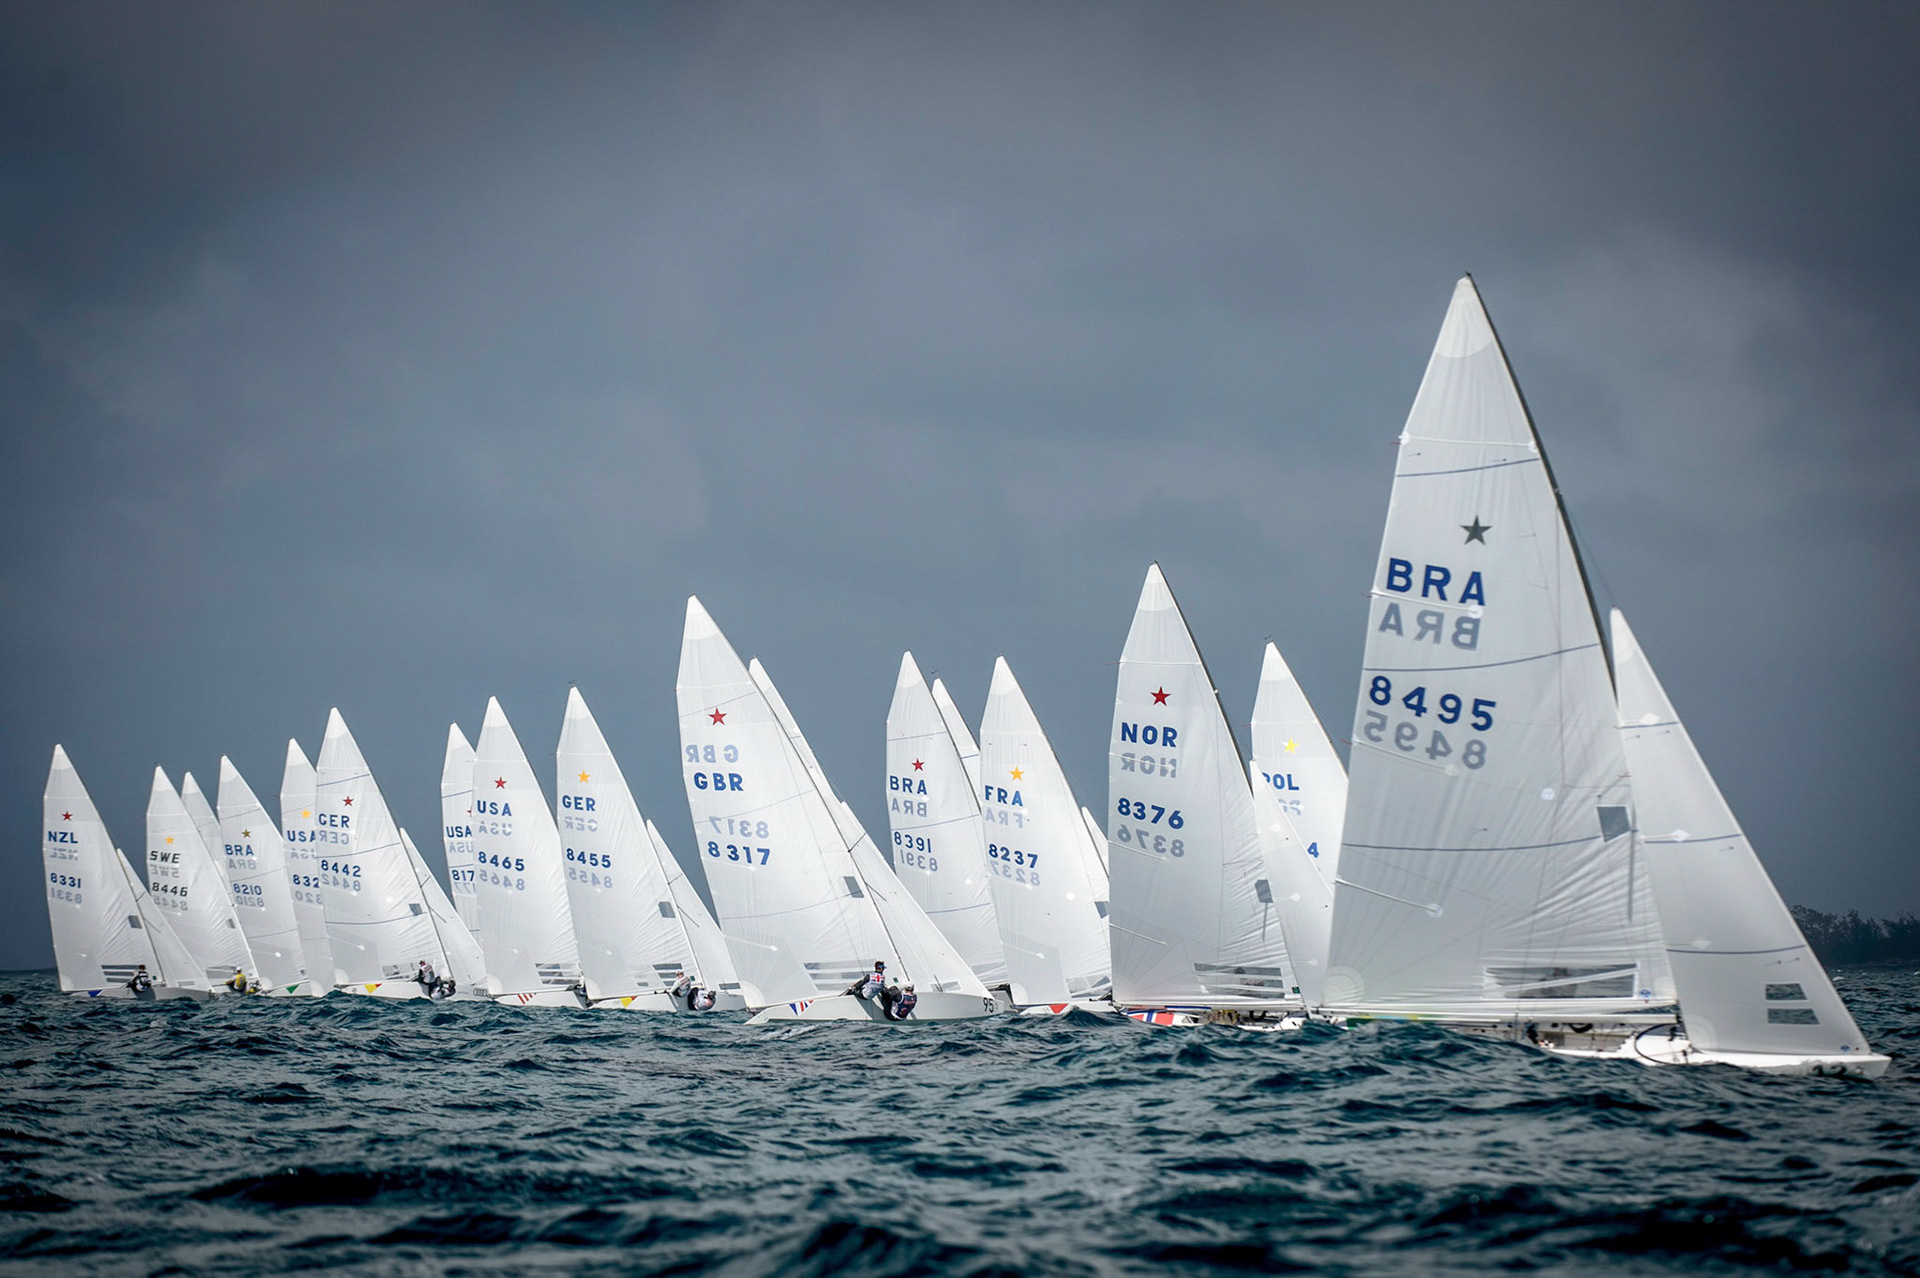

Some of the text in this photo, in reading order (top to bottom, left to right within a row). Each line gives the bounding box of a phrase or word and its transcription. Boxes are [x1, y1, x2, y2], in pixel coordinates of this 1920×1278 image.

[1386, 557, 1486, 606] BRA
[1369, 675, 1496, 732] 8495
[1121, 722, 1178, 747] NOR
[693, 772, 744, 791] GBR
[889, 775, 928, 795] BRA
[562, 794, 596, 812] GER
[984, 784, 1024, 807] FRA
[477, 799, 512, 817] USA
[1117, 797, 1184, 830] 8376
[318, 813, 350, 829] GER
[47, 830, 79, 844] NZL
[446, 825, 473, 838] USA
[224, 844, 254, 857] BRA
[893, 831, 932, 854] 8391
[149, 850, 181, 864] SWE
[478, 851, 525, 872] 8465
[566, 848, 612, 868] 8455
[707, 840, 770, 866] 8317
[988, 843, 1038, 869] 8237
[320, 859, 361, 878] 8442
[451, 869, 475, 882] 817
[50, 872, 82, 889] 8331
[152, 881, 189, 897] 8446
[232, 882, 263, 896] 8210
[292, 874, 320, 889] 832
[983, 997, 995, 1014] 95
